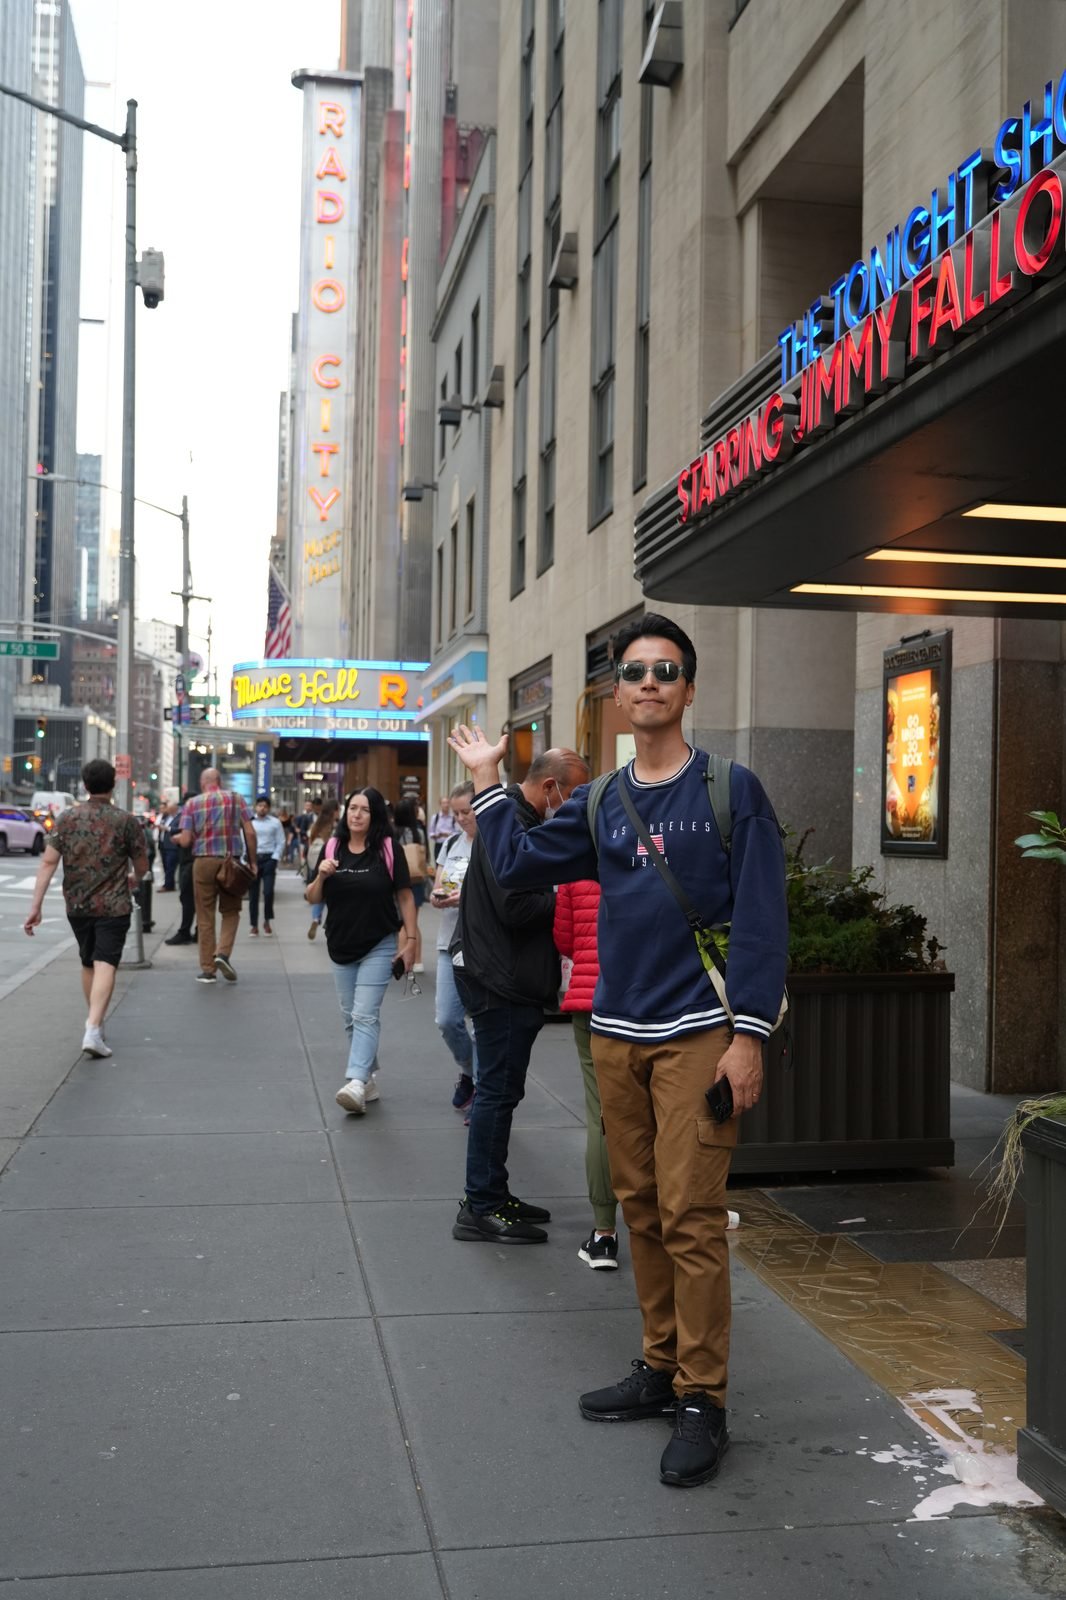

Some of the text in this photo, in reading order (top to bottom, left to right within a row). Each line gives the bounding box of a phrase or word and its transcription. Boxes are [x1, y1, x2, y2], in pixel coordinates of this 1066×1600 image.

[777, 298, 822, 387] THE
[829, 147, 982, 344] TONIGHT
[308, 101, 347, 521] RADIO CITY
[677, 168, 1066, 525] STARRING JIMMY FALLO
[10, 643, 24, 654] 50
[234, 672, 292, 709] Music
[285, 668, 360, 708] Hall
[326, 717, 369, 731] SOLD
[377, 719, 407, 732] OUT
[907, 714, 920, 729] GO
[902, 752, 923, 768] ROCK
[612, 821, 711, 839] OS NGELES
